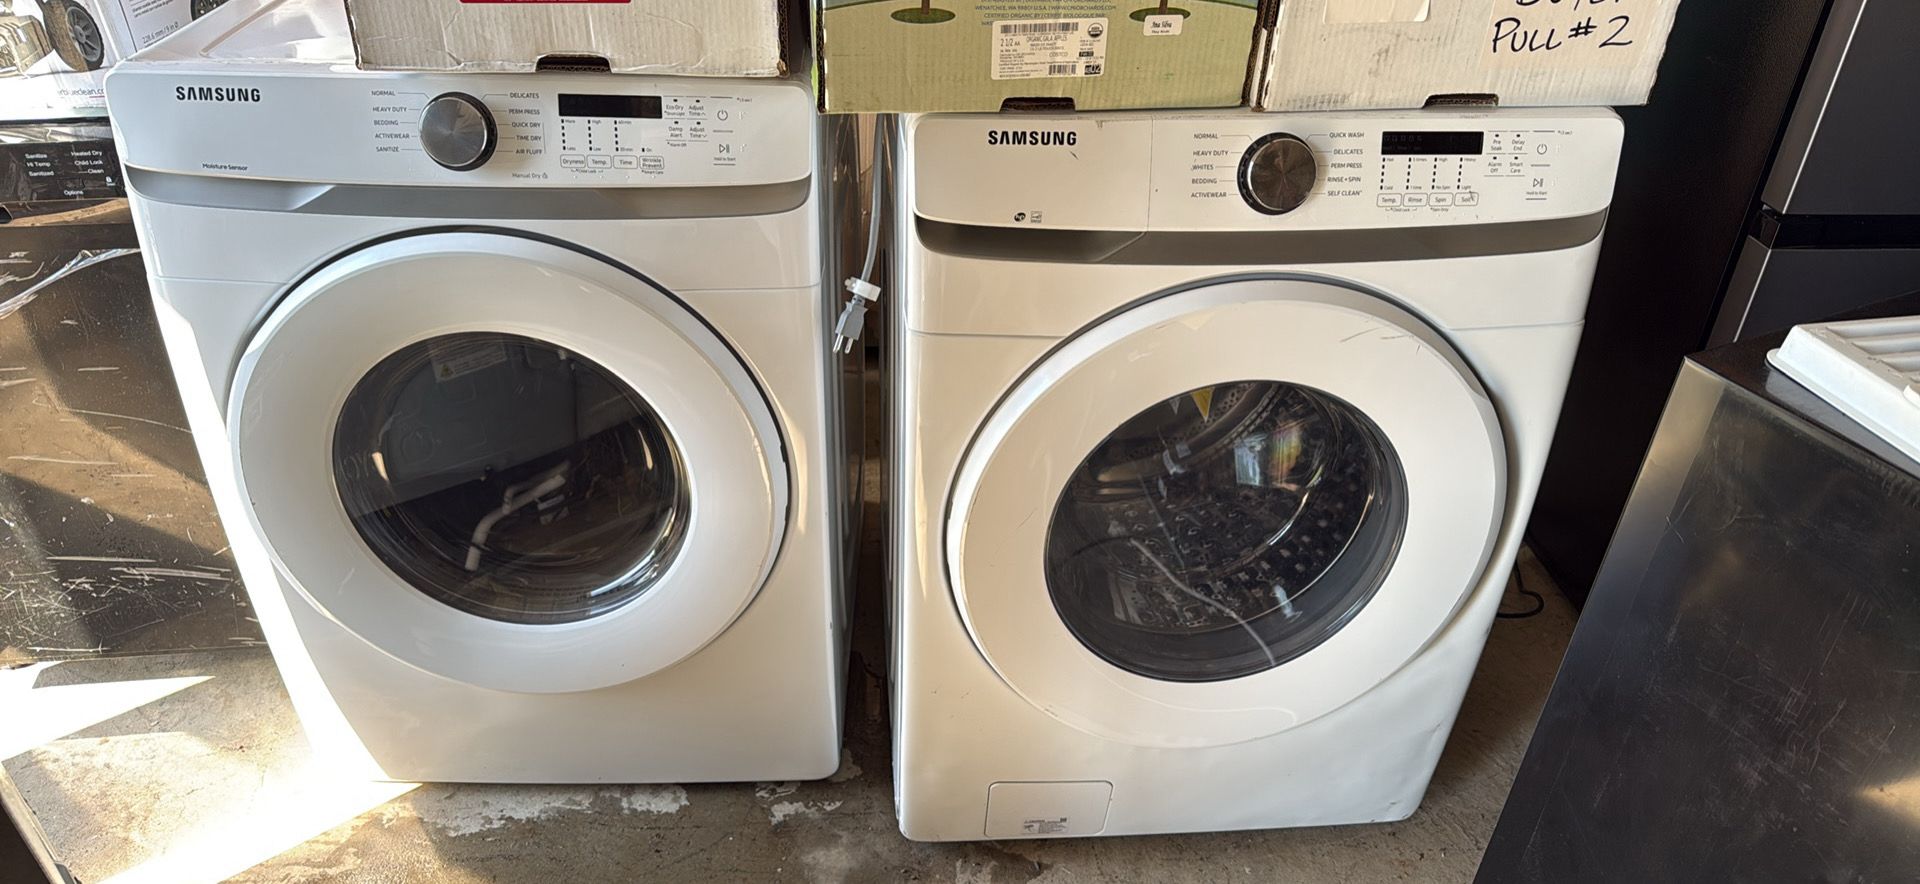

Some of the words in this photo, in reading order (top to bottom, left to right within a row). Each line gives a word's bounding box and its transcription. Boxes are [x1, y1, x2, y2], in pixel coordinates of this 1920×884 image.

[1000, 38, 1004, 47] 2
[1492, 17, 1562, 53] PULL
[176, 86, 261, 102] SAMSUNG
[988, 130, 1077, 146] SAMSUNG
